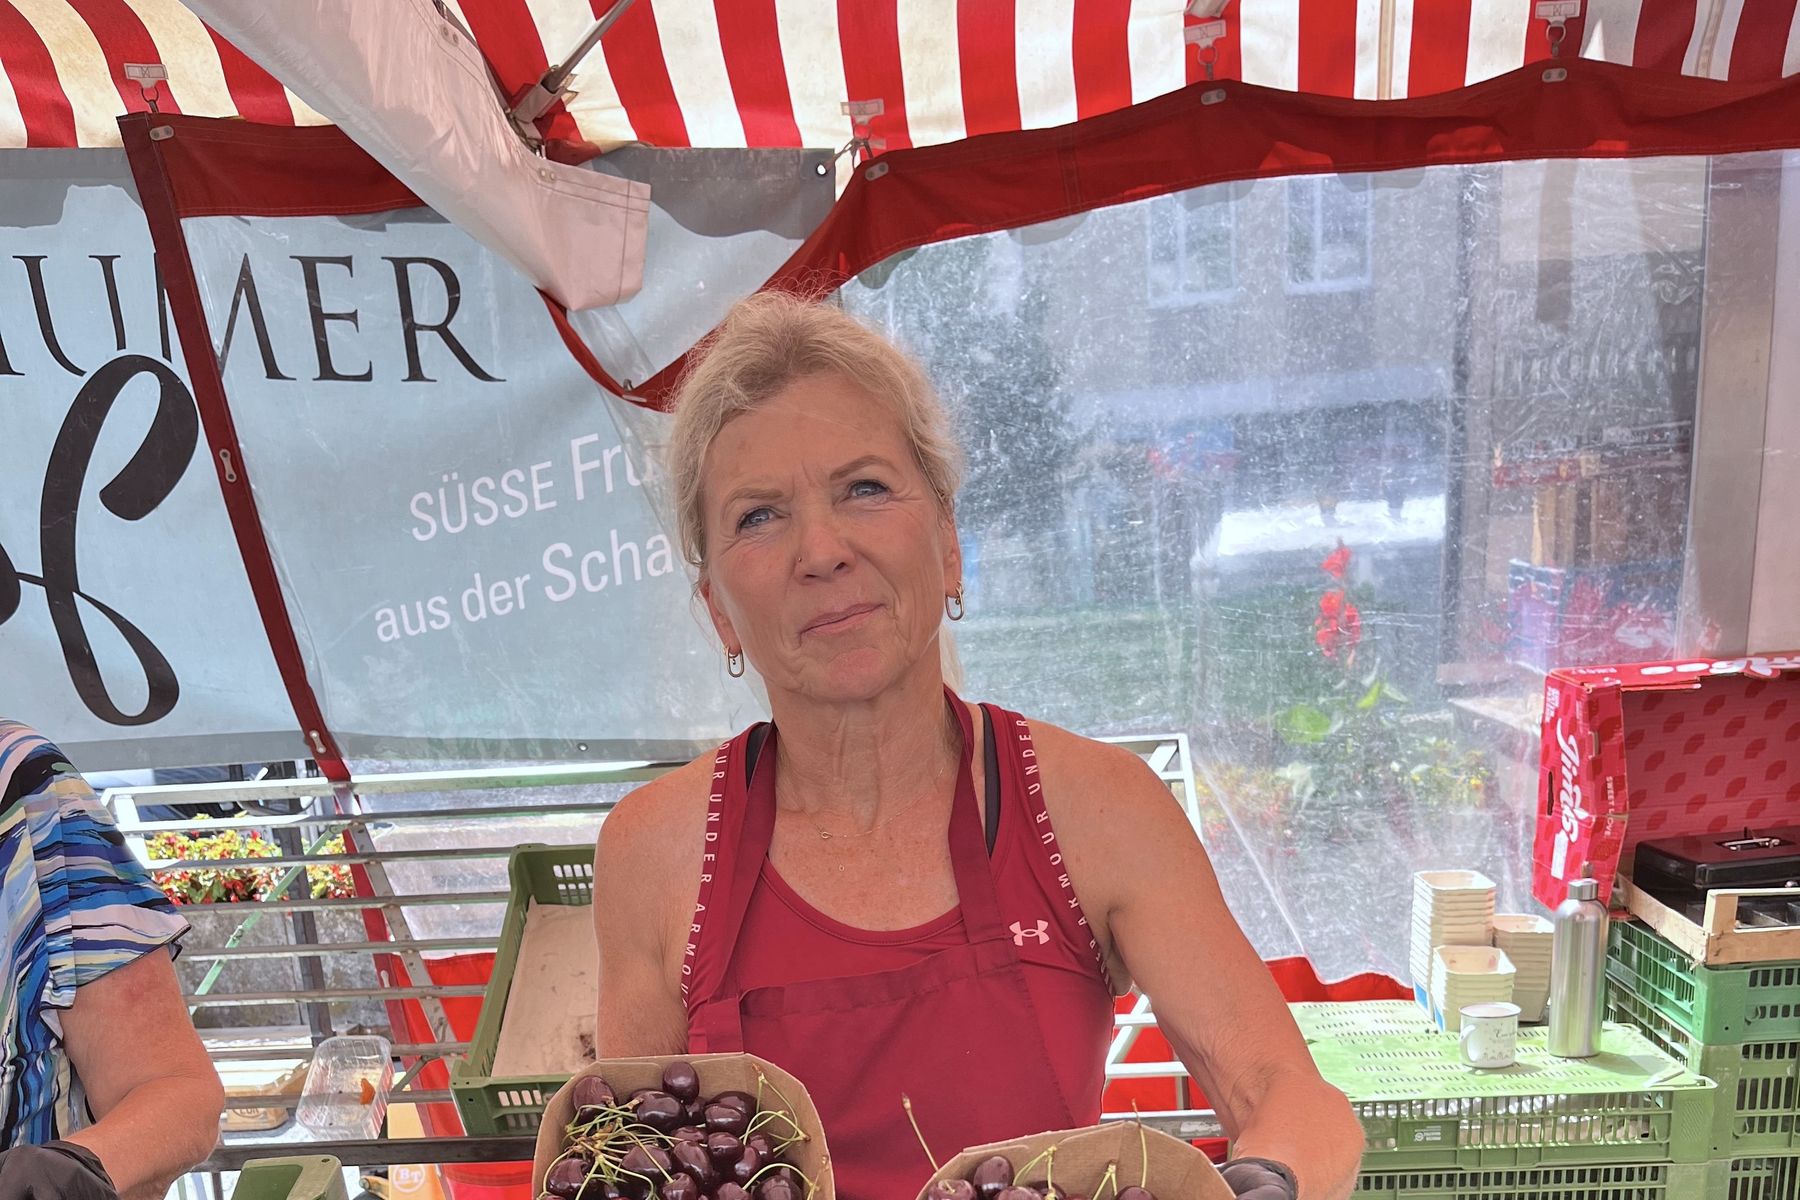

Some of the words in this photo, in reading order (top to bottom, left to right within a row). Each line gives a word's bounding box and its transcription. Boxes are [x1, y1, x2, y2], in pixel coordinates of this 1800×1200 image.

[0, 249, 506, 383] UMER
[409, 460, 557, 542] SÜSSE
[374, 595, 451, 643] aus
[460, 572, 531, 623] der
[541, 528, 675, 602] Scha
[1016, 719, 1042, 796] UNDER
[700, 793, 723, 883] UNDER
[1035, 809, 1088, 927] ARMOUR
